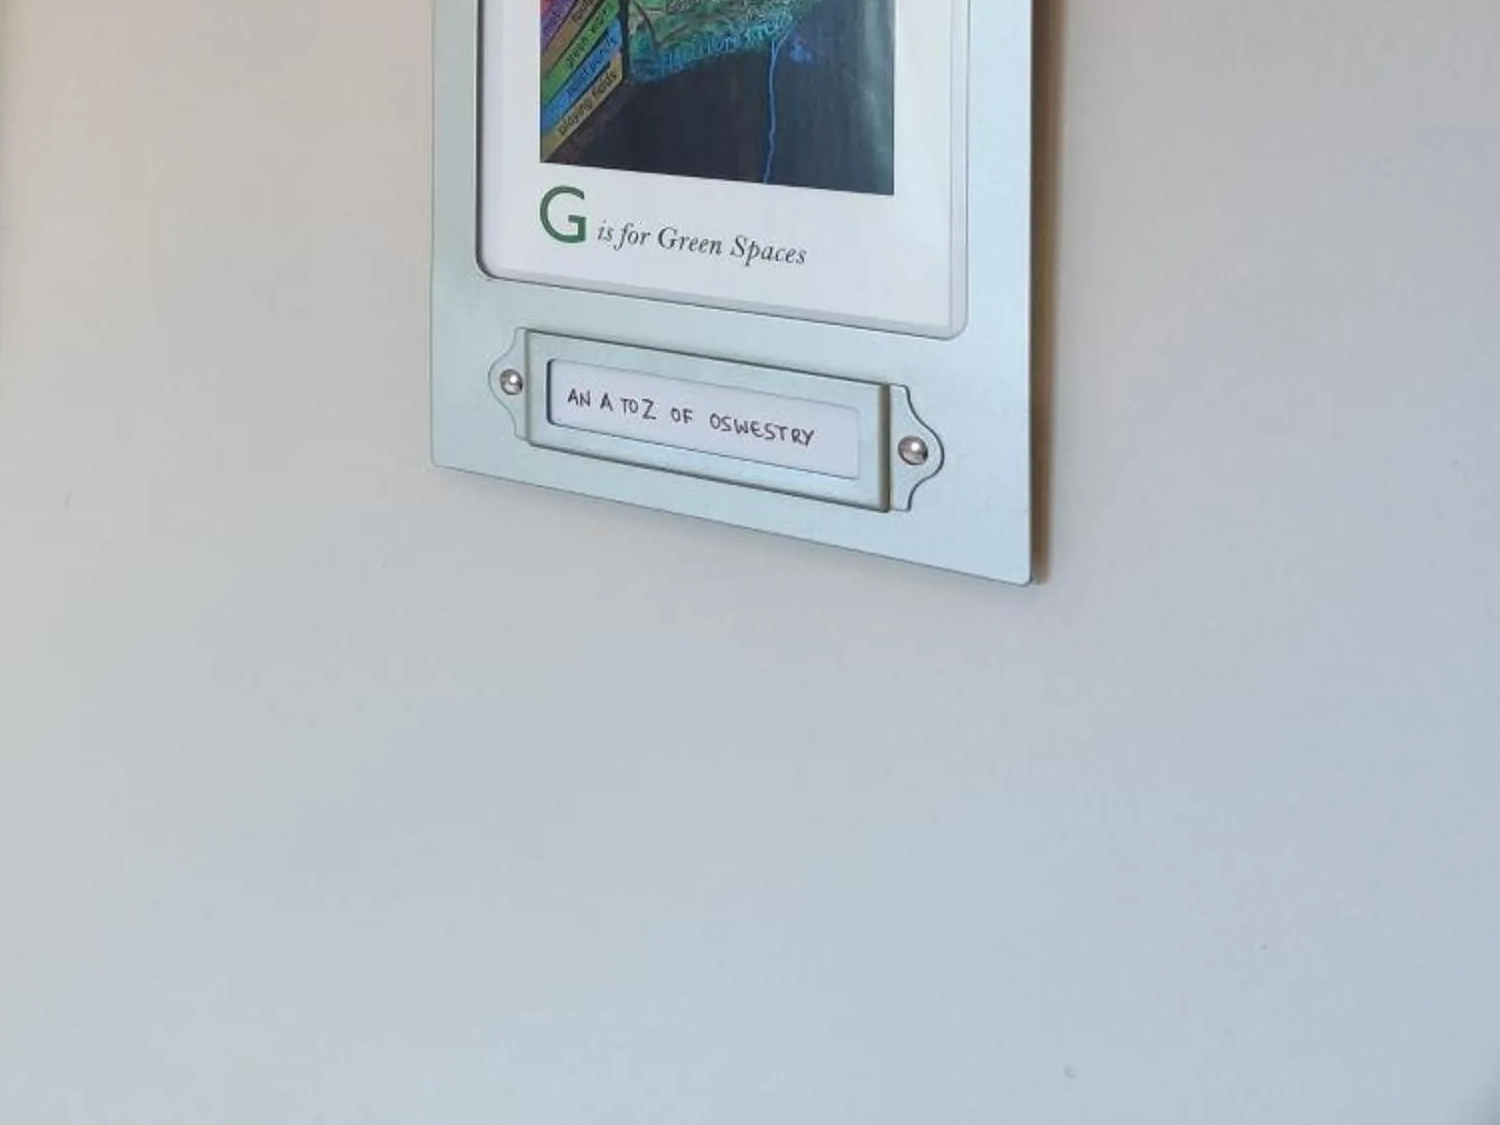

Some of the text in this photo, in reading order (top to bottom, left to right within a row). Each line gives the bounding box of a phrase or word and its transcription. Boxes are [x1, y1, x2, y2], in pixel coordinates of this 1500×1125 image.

[539, 185, 807, 265] G is for Green Spaces
[567, 389, 591, 408] AN
[600, 395, 614, 412] A
[671, 406, 694, 425] OF
[710, 413, 816, 447] OSWESTRY
